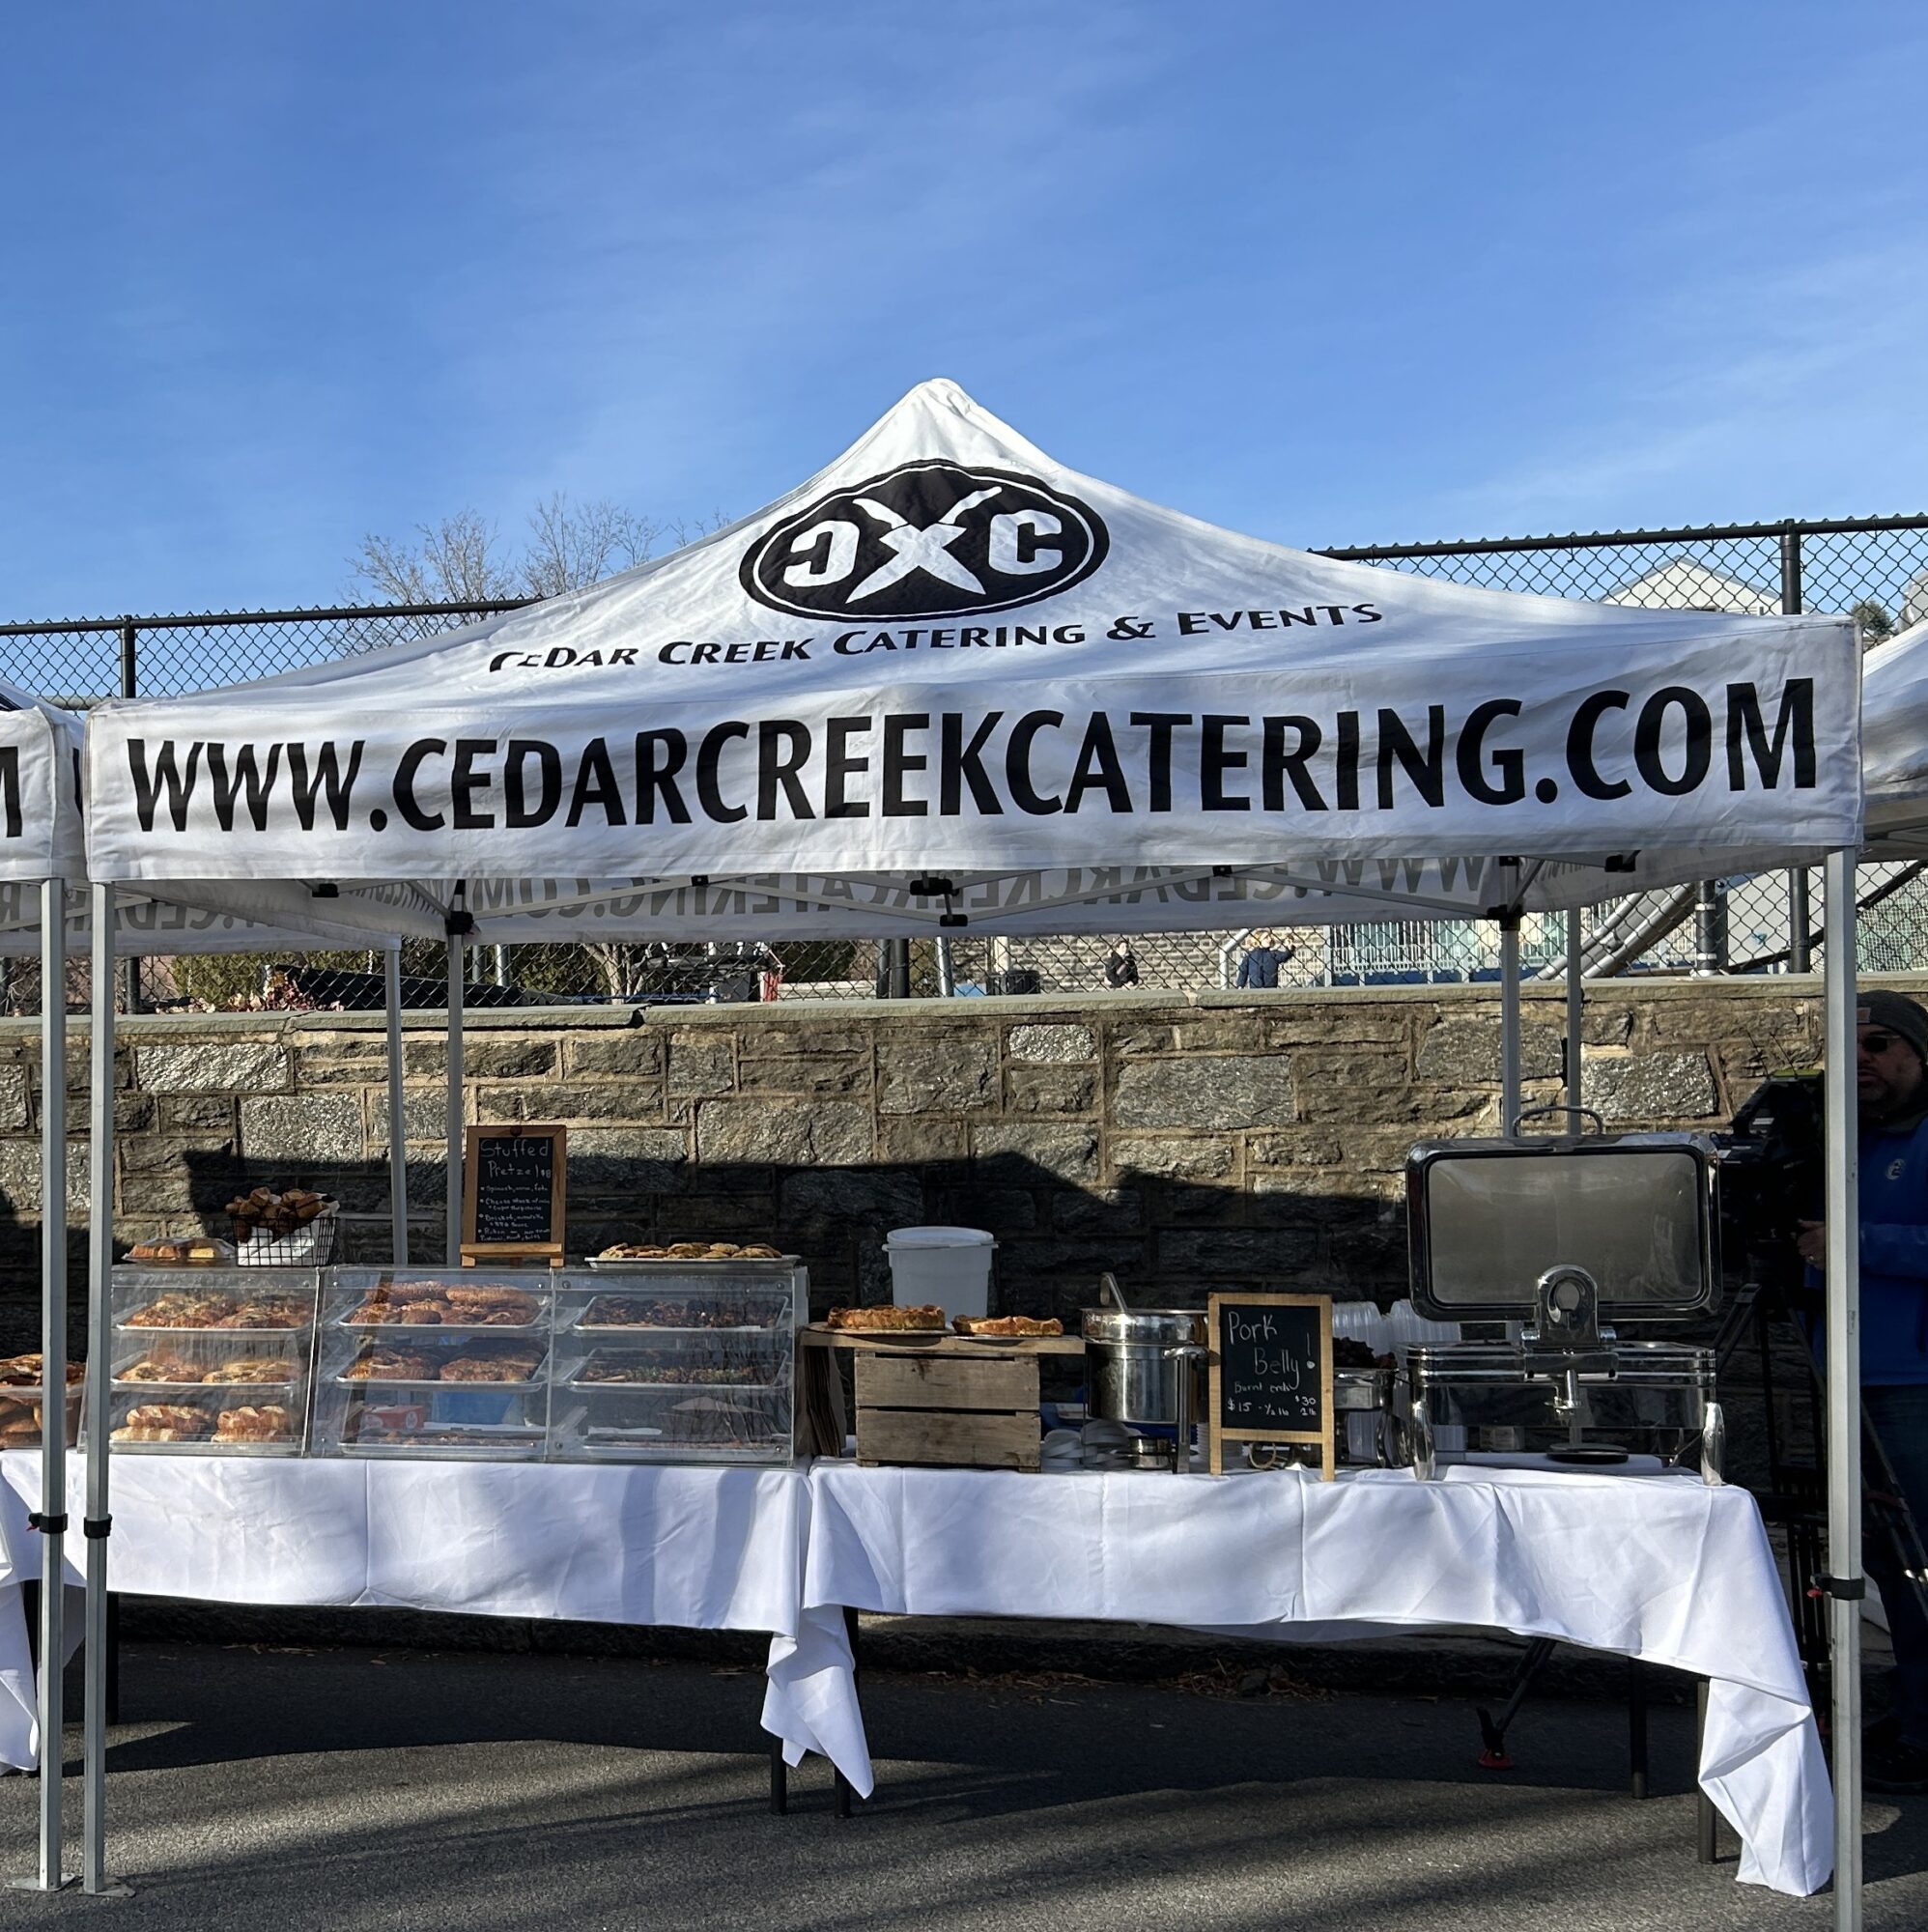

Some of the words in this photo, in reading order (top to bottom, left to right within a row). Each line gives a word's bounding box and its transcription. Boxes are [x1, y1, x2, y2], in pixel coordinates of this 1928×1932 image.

[658, 638, 816, 667] CREEK
[834, 624, 1086, 656] CATERING
[1106, 615, 1156, 640] &
[1177, 603, 1383, 637] EVENTS
[127, 677, 1817, 834] WWW.CEDARCREEKCATERING.COM
[480, 1138, 550, 1158] Stuffed
[487, 1159, 539, 1179] Pretzel
[1228, 1311, 1278, 1345] Pork
